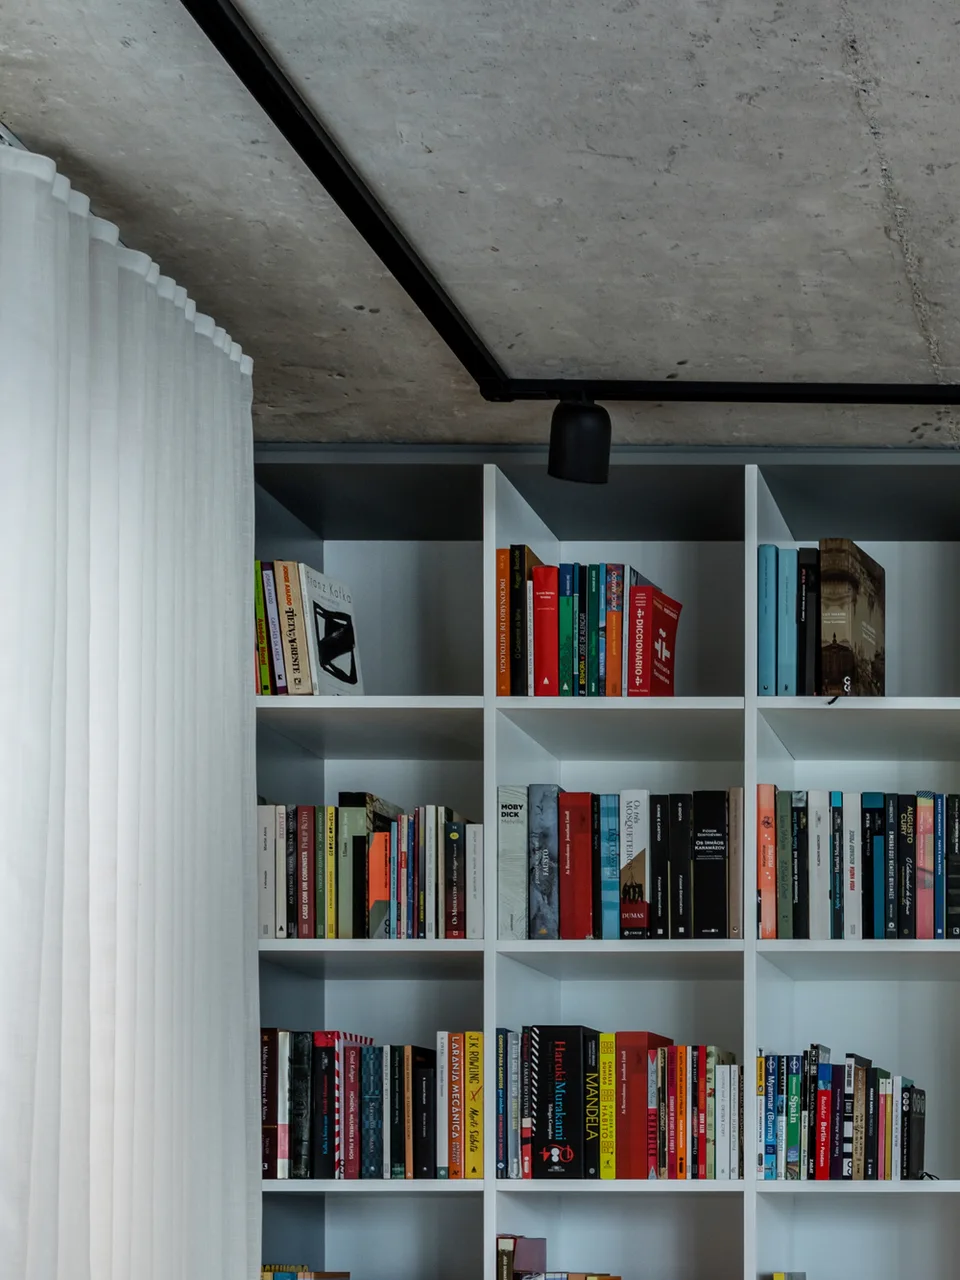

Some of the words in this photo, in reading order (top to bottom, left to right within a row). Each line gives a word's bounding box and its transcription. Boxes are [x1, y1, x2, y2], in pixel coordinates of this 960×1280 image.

[264, 572, 273, 589] JORGE
[282, 565, 291, 583] JORGE
[285, 584, 293, 606] AMADO
[499, 578, 508, 620] DICIONÁRIO
[499, 621, 507, 632] DE
[578, 643, 586, 656] JOSÉ
[580, 635, 586, 643] DE
[634, 619, 644, 676] DICCIONARIO
[499, 632, 507, 673] MITOLOGIA
[633, 799, 641, 810] Os
[301, 811, 309, 830] ROTH
[633, 811, 641, 825] três
[900, 813, 908, 837] CURY
[906, 805, 914, 845] AUGUSTO
[624, 800, 634, 871] MOSQUETEIROS
[848, 829, 856, 846] PRICE
[301, 850, 309, 881] COMUNISTA
[542, 848, 550, 877] FAUSTO
[848, 846, 856, 865] RICHARD
[301, 881, 309, 891] UM
[301, 891, 309, 904] COM
[301, 904, 309, 920] CASEI
[451, 1036, 461, 1082] LARANJA
[554, 1040, 568, 1082] Haruki
[348, 1064, 356, 1083] Kultgen
[766, 1074, 776, 1111] Myanmar
[451, 1084, 462, 1139] MECÂNICA
[468, 1107, 480, 1128] Morte
[553, 1081, 568, 1141] Murakami
[585, 1072, 599, 1141] MANDELA
[789, 1095, 799, 1124] Spain
[766, 1111, 776, 1142] (Burma)
[820, 1121, 828, 1142] Berlin
[468, 1129, 481, 1153] Súbita
